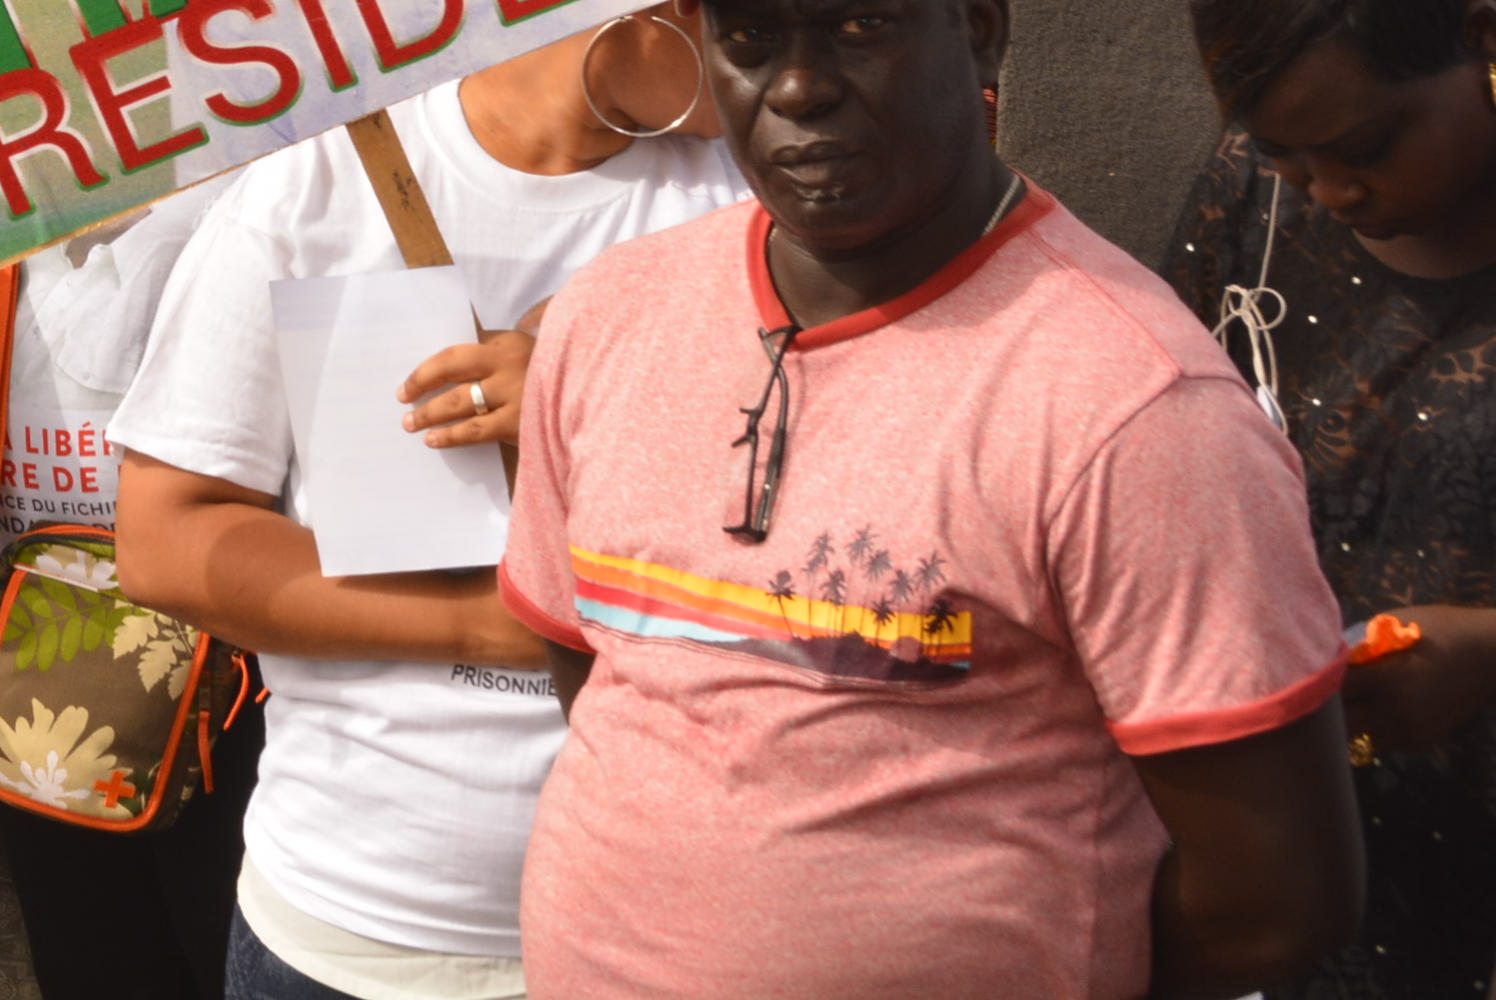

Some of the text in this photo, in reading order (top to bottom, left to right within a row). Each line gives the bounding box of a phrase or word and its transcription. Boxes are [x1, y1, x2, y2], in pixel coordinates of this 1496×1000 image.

[53, 466, 100, 493] DE
[33, 499, 55, 513] DU
[62, 502, 117, 516] FICHI
